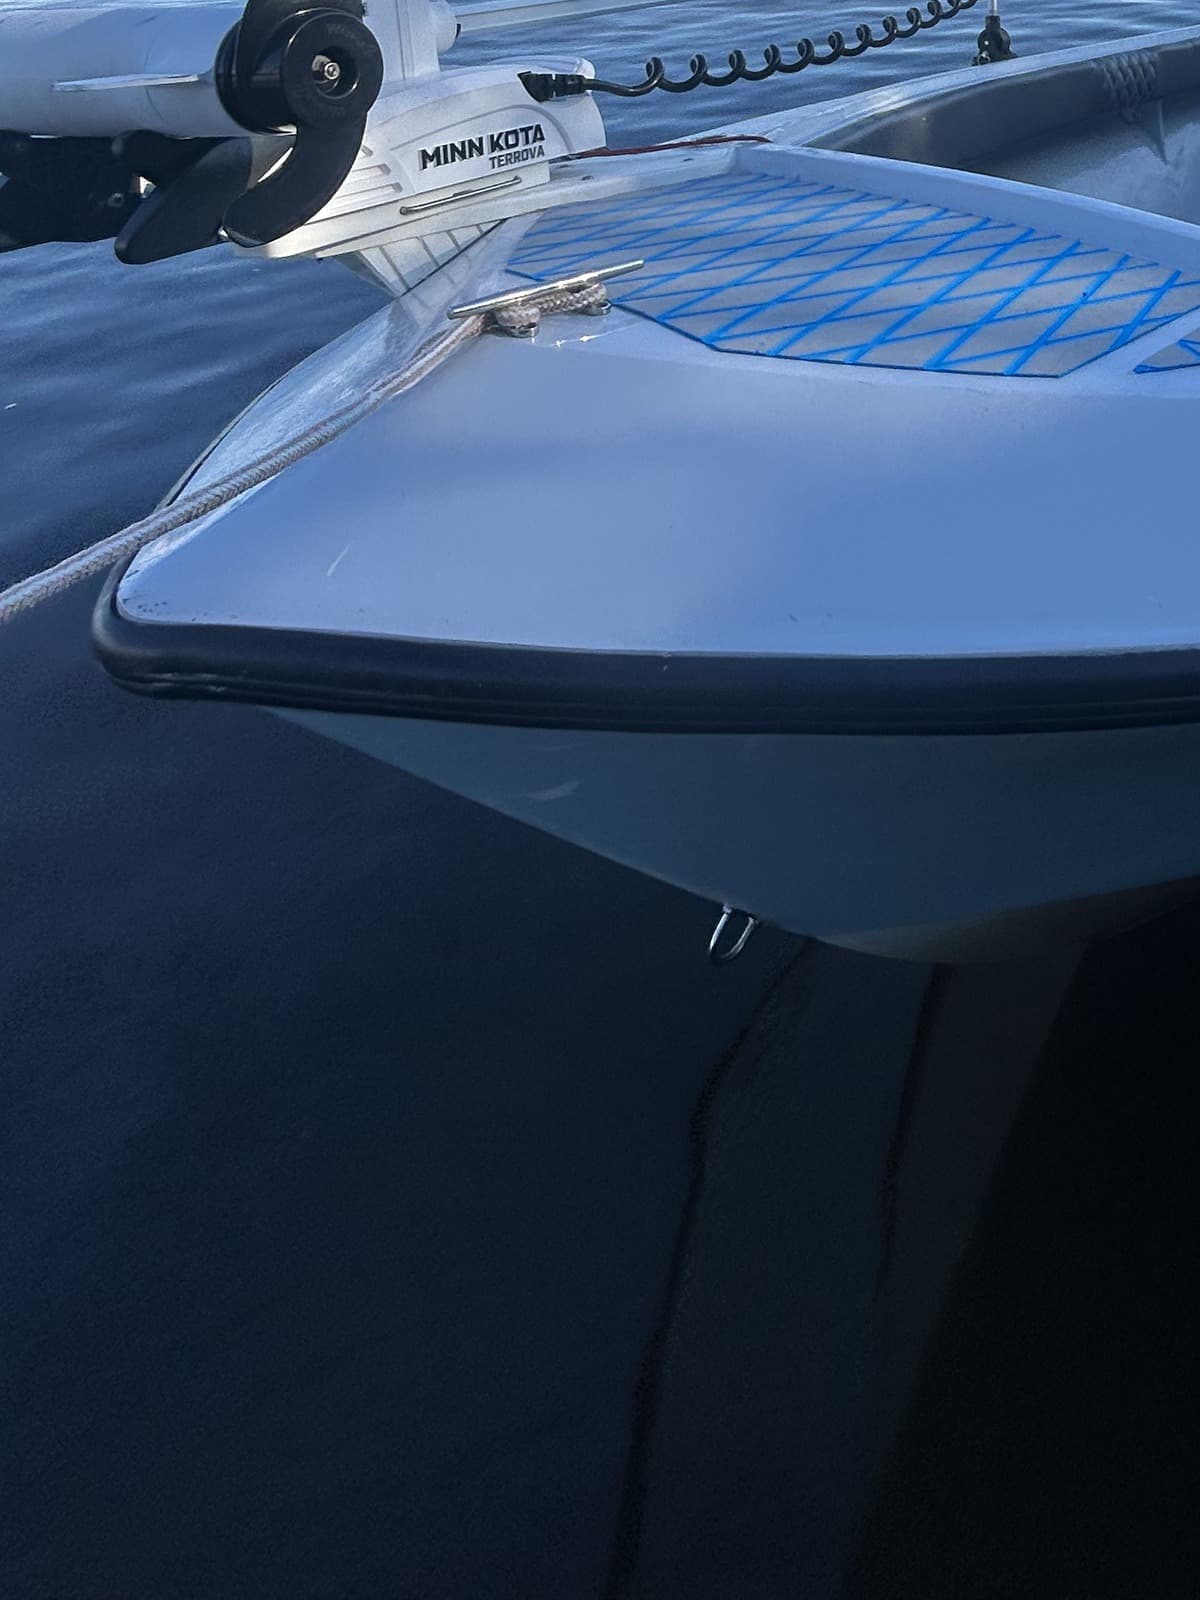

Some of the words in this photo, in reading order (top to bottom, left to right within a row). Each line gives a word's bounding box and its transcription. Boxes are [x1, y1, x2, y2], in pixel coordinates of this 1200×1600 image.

[419, 136, 484, 171] MINN
[488, 124, 546, 154] KOTA
[489, 145, 545, 169] TERROVA
